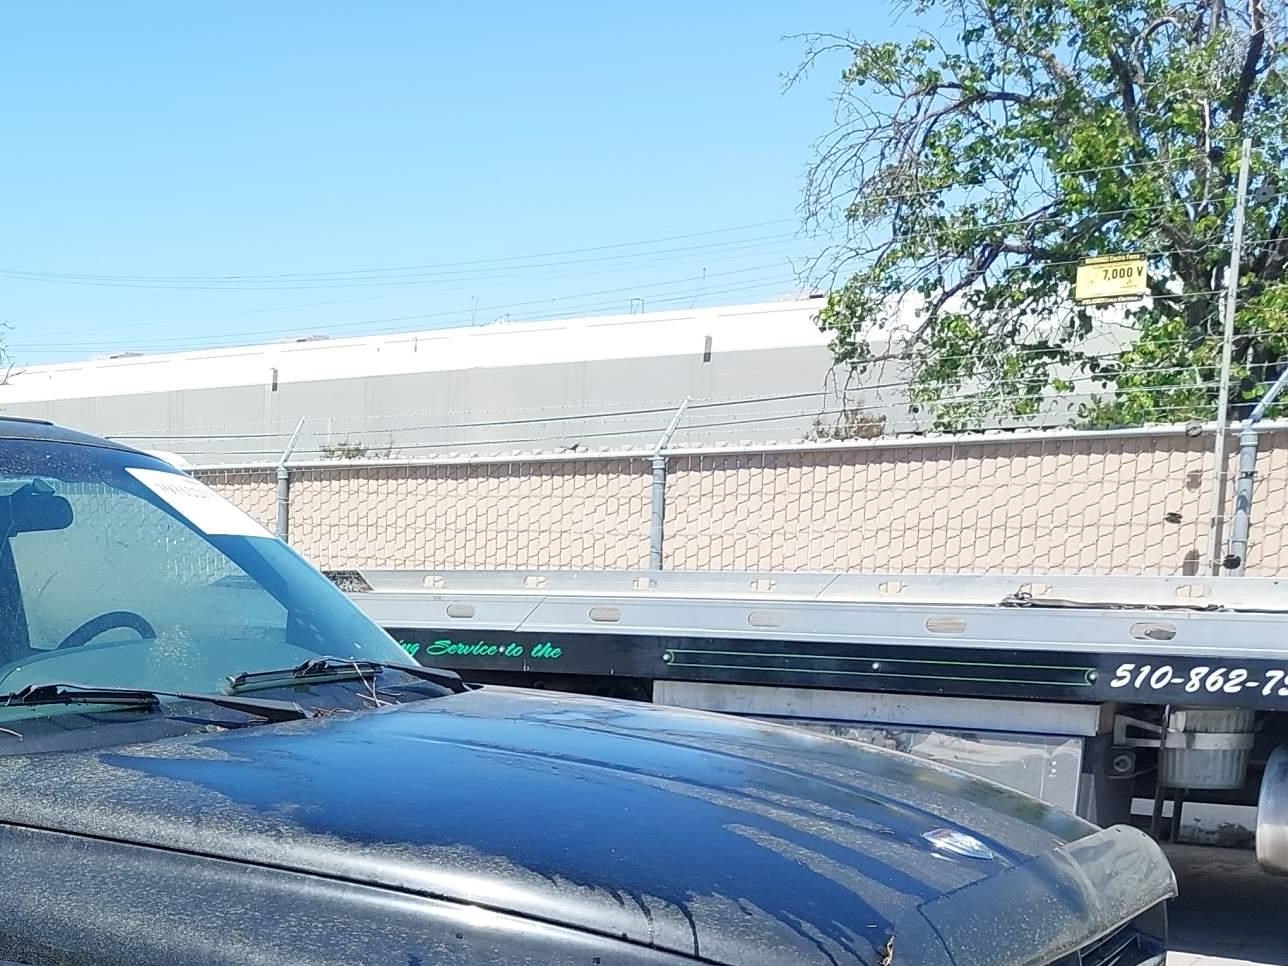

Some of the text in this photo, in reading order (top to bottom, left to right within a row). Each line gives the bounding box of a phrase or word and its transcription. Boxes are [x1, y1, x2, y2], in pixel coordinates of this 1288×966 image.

[1103, 266, 1144, 280] 7,000 V
[426, 640, 499, 656] Service
[504, 642, 524, 657] to
[531, 641, 562, 658] the
